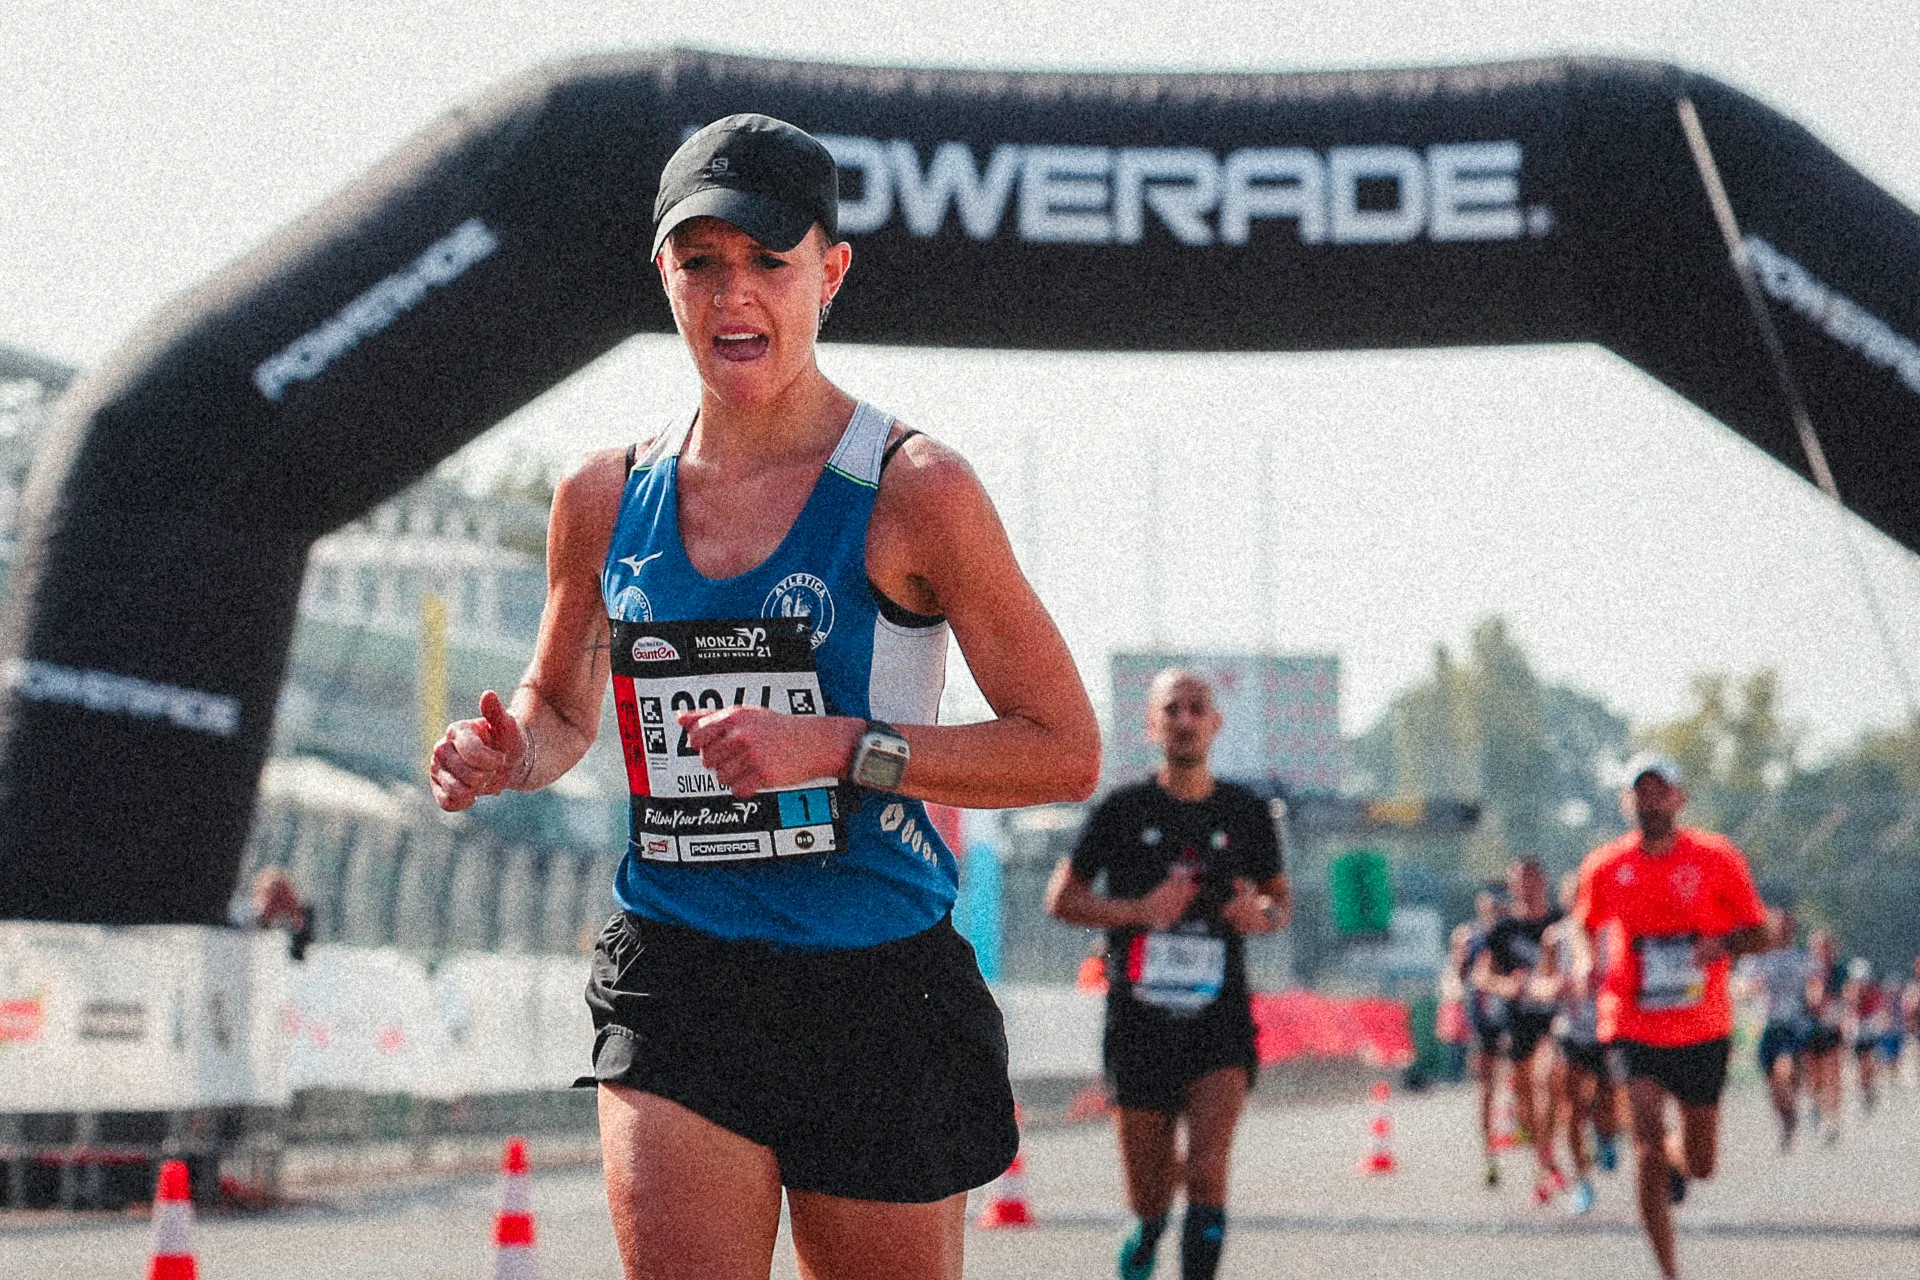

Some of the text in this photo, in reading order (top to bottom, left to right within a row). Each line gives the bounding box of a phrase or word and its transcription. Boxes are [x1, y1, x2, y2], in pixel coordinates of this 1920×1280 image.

[682, 126, 1523, 245] OWERADE
[775, 574, 826, 599] ATLETICA
[695, 635, 747, 649] MONZA
[756, 646, 771, 658] 21
[677, 774, 715, 793] SILVIA
[798, 794, 811, 821] 1
[691, 842, 757, 854] POWERADE
